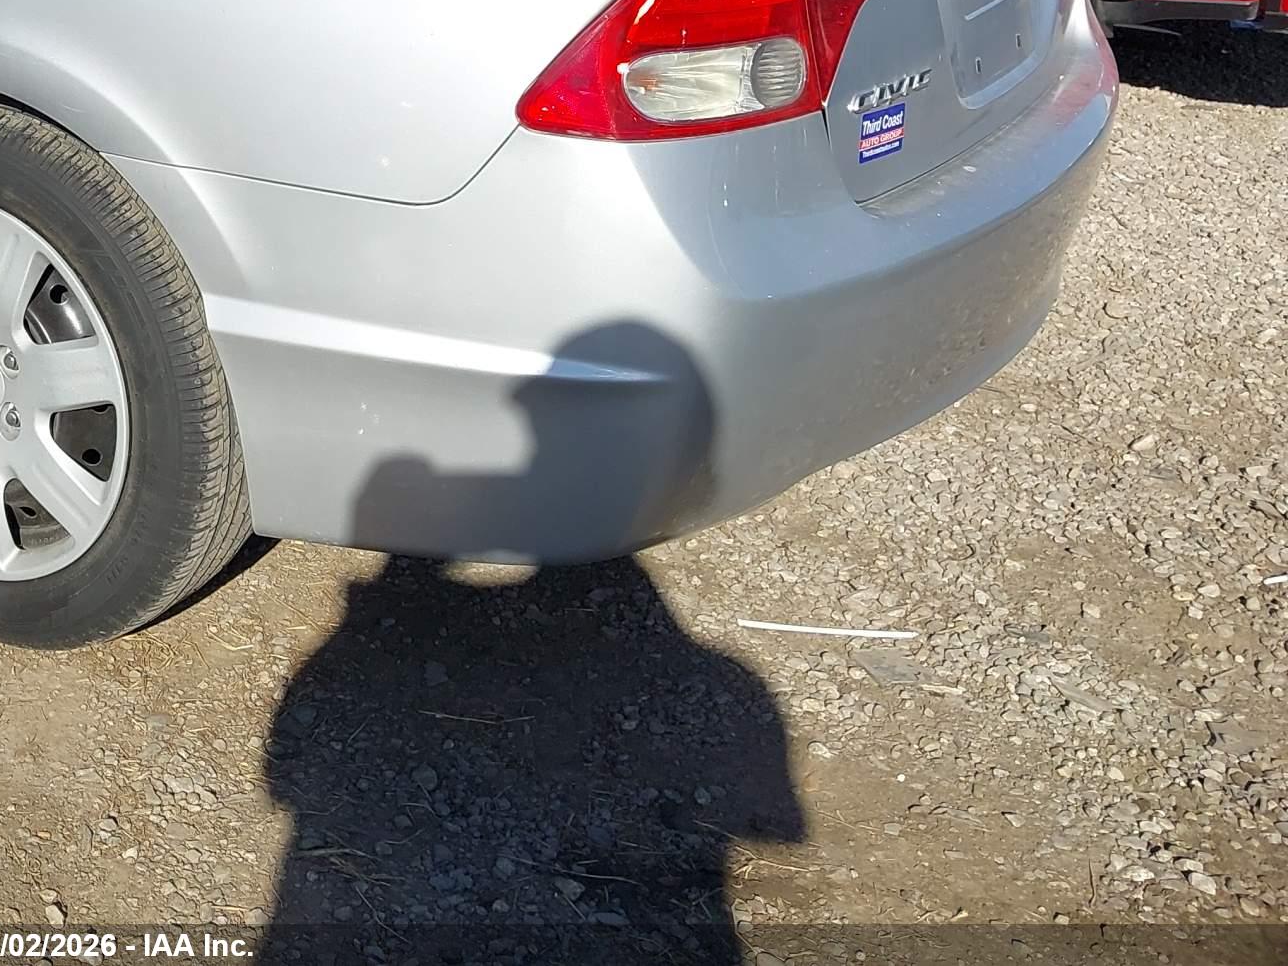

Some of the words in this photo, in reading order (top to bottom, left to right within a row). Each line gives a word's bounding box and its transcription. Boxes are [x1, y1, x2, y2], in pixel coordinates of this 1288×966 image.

[846, 68, 932, 115] CIVIC
[862, 117, 882, 137] Third
[882, 110, 904, 130] Coast
[861, 135, 880, 149] AUTO
[880, 128, 903, 144] GROUP
